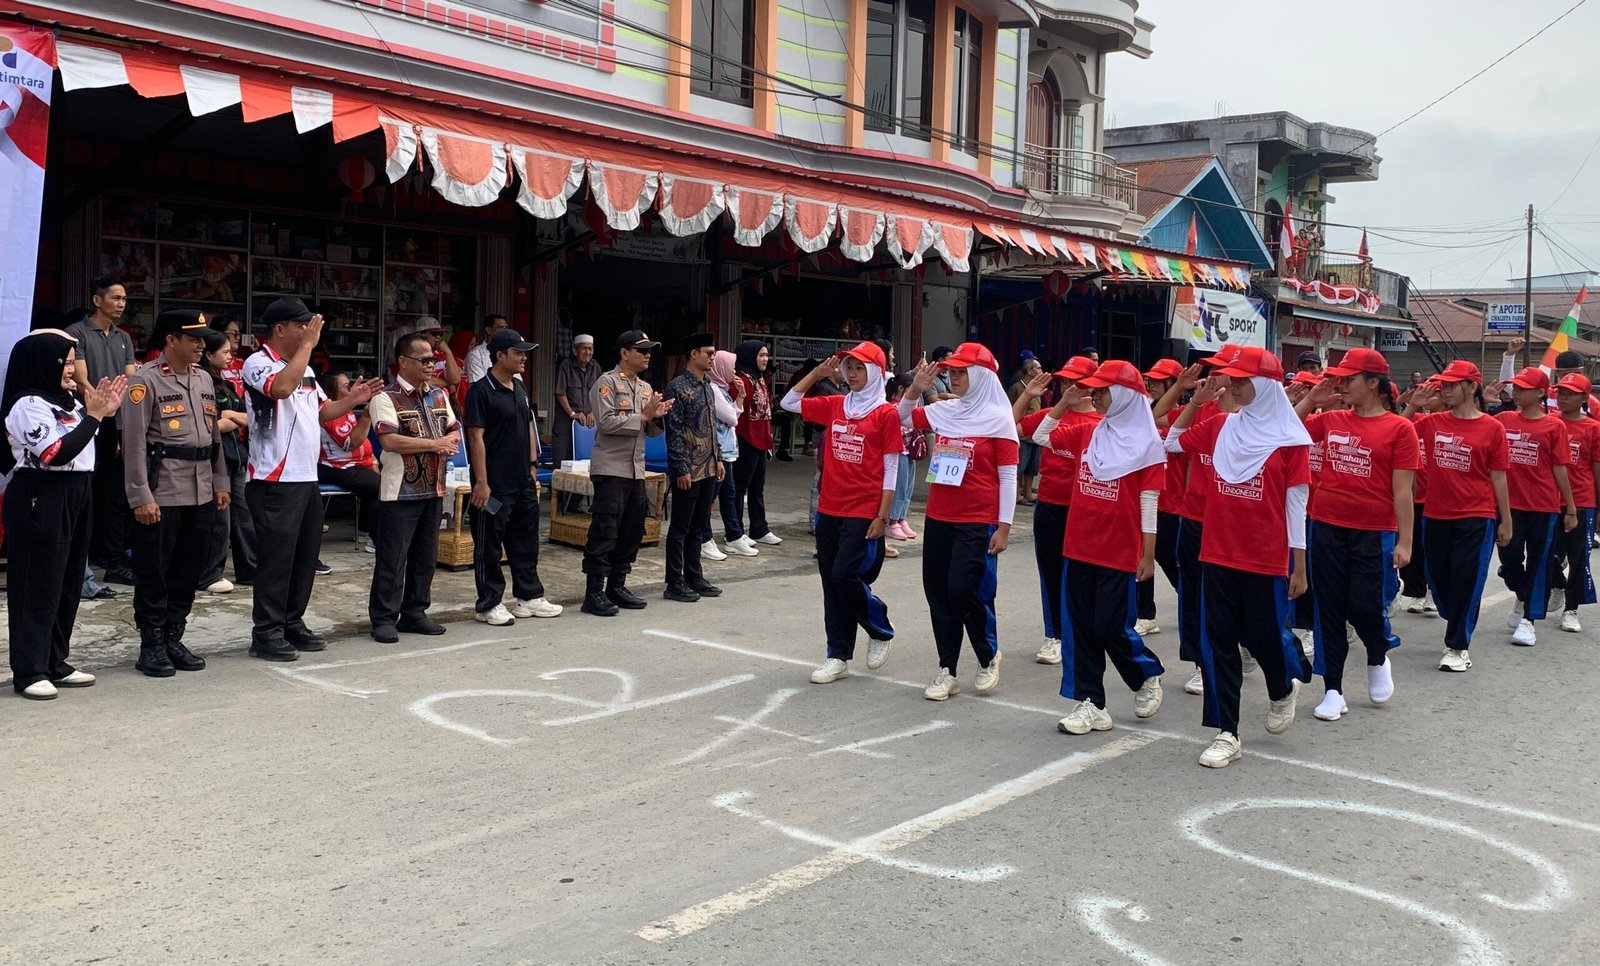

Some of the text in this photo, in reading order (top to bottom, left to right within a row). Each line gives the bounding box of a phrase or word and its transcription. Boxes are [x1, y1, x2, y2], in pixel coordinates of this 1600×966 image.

[1229, 317, 1258, 333] SPORT
[1385, 332, 1403, 340] CUCI
[1381, 339, 1406, 347] AMBAL
[945, 465, 960, 477] 10
[1337, 462, 1369, 476] INDONESIA
[1085, 486, 1117, 499] INDONESIA
[1224, 485, 1260, 499] INDONESIA
